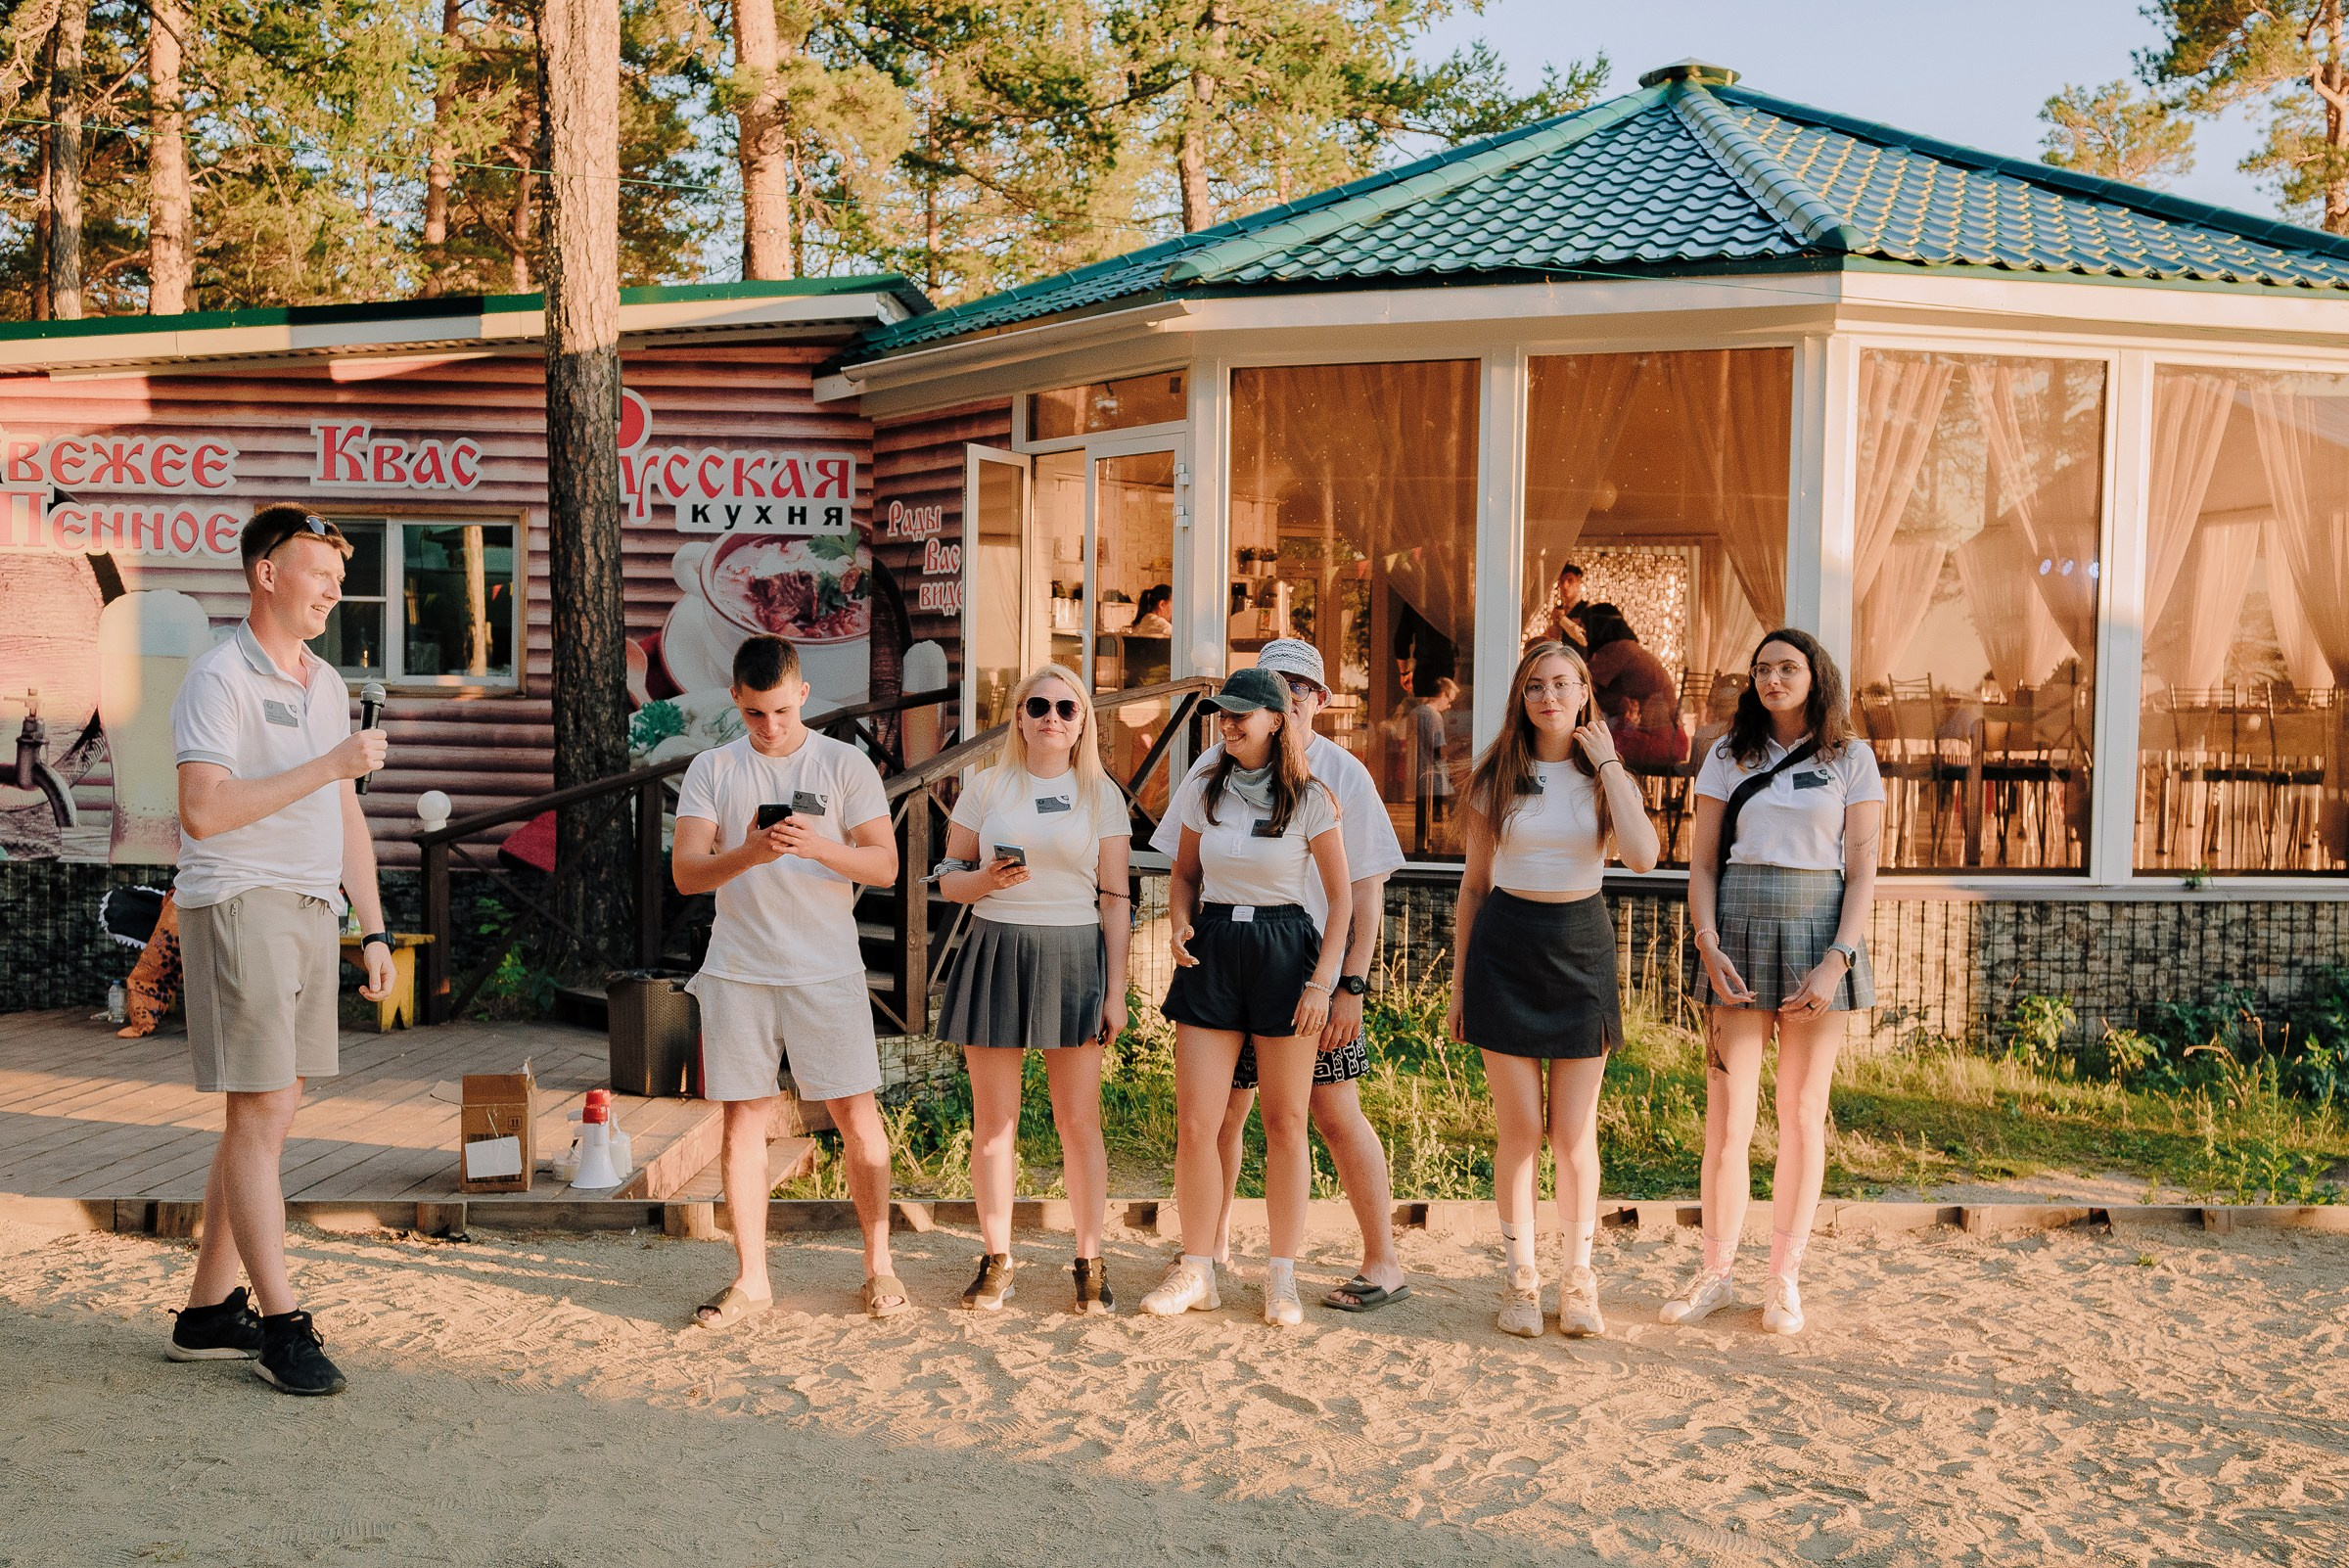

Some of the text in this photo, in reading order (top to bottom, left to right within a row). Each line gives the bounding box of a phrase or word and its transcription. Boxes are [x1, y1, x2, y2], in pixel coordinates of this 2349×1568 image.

[0, 440, 230, 488] вежее
[316, 425, 478, 486] Квас
[691, 503, 844, 530] кухня
[889, 502, 941, 536] Рады
[924, 540, 959, 572] Вас
